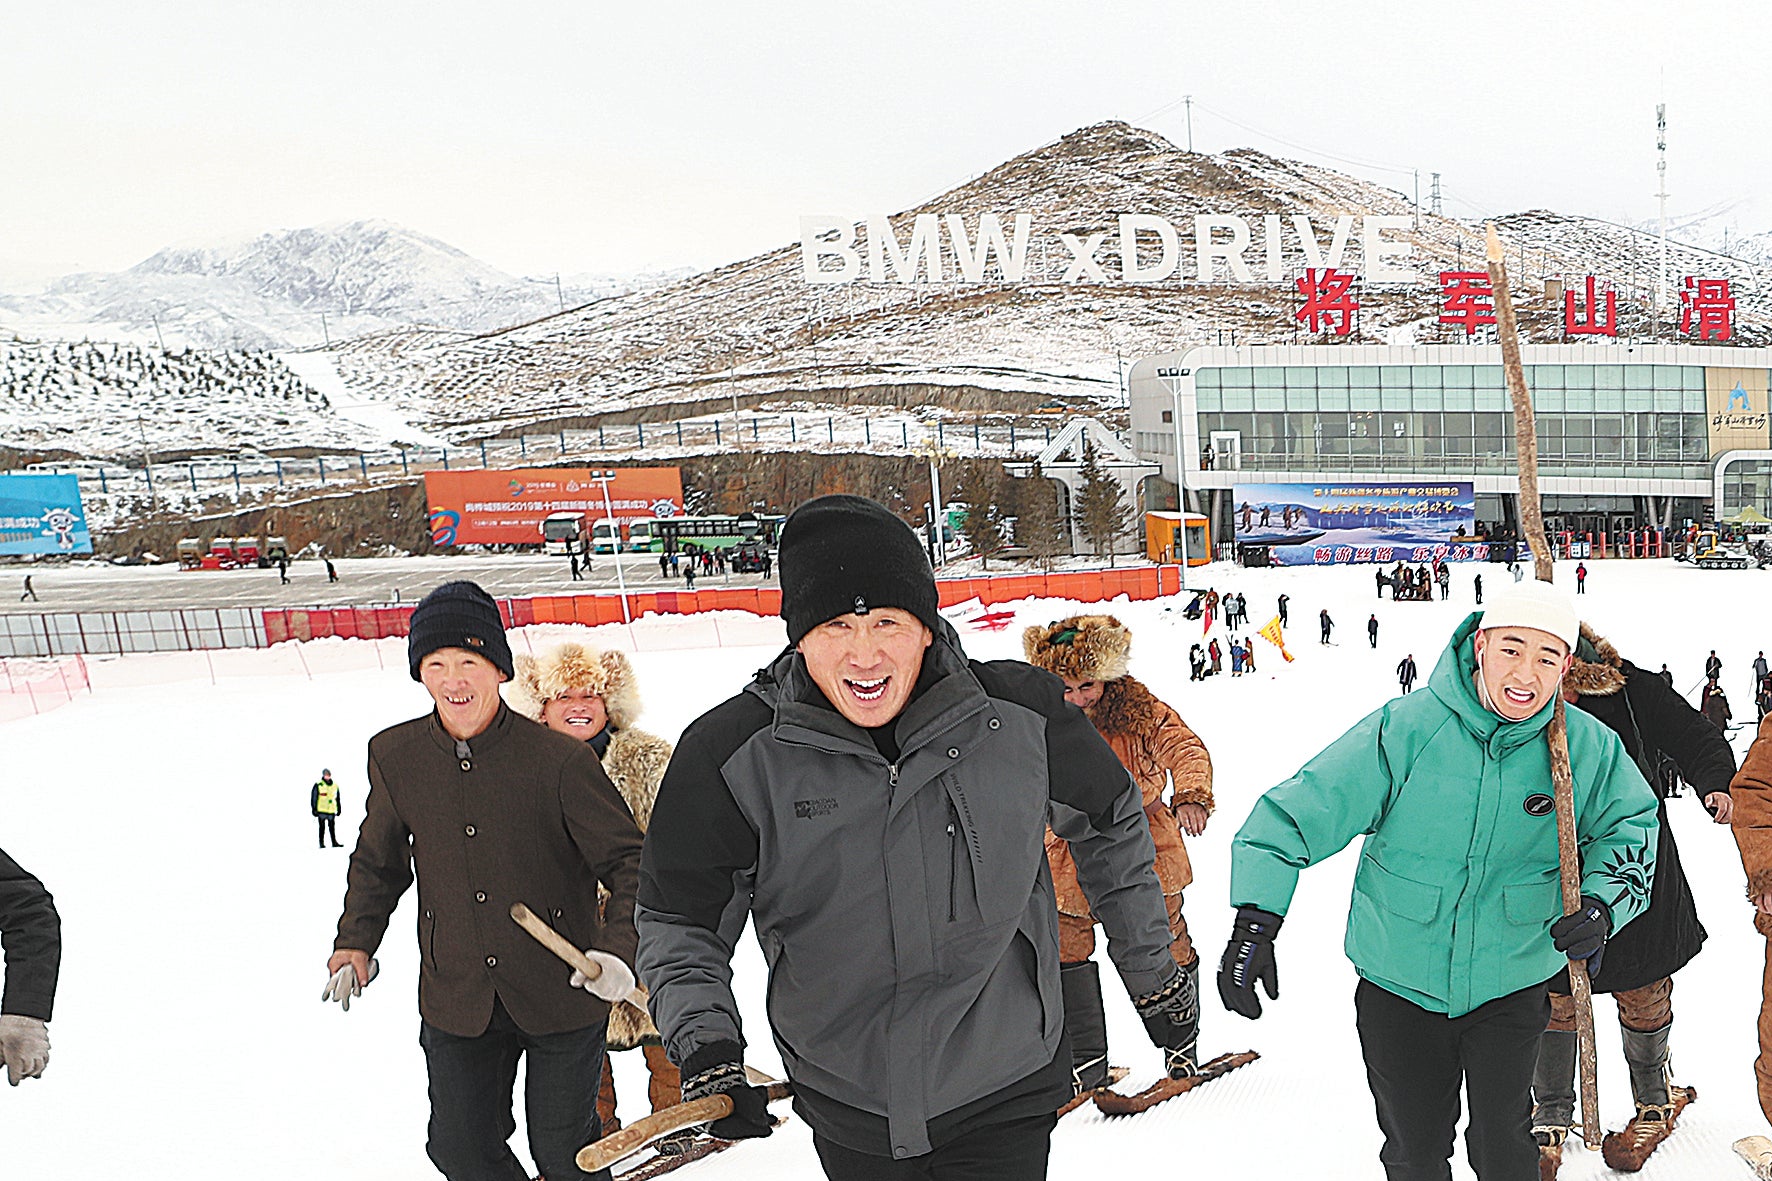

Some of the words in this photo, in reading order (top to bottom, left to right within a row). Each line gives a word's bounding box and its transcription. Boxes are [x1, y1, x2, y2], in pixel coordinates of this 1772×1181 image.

[800, 213, 1032, 284] BMW
[1061, 213, 1417, 284] xDRIVE
[1313, 546, 1393, 563] 畅游丝路
[1411, 543, 1490, 561] 乐享冰雪
